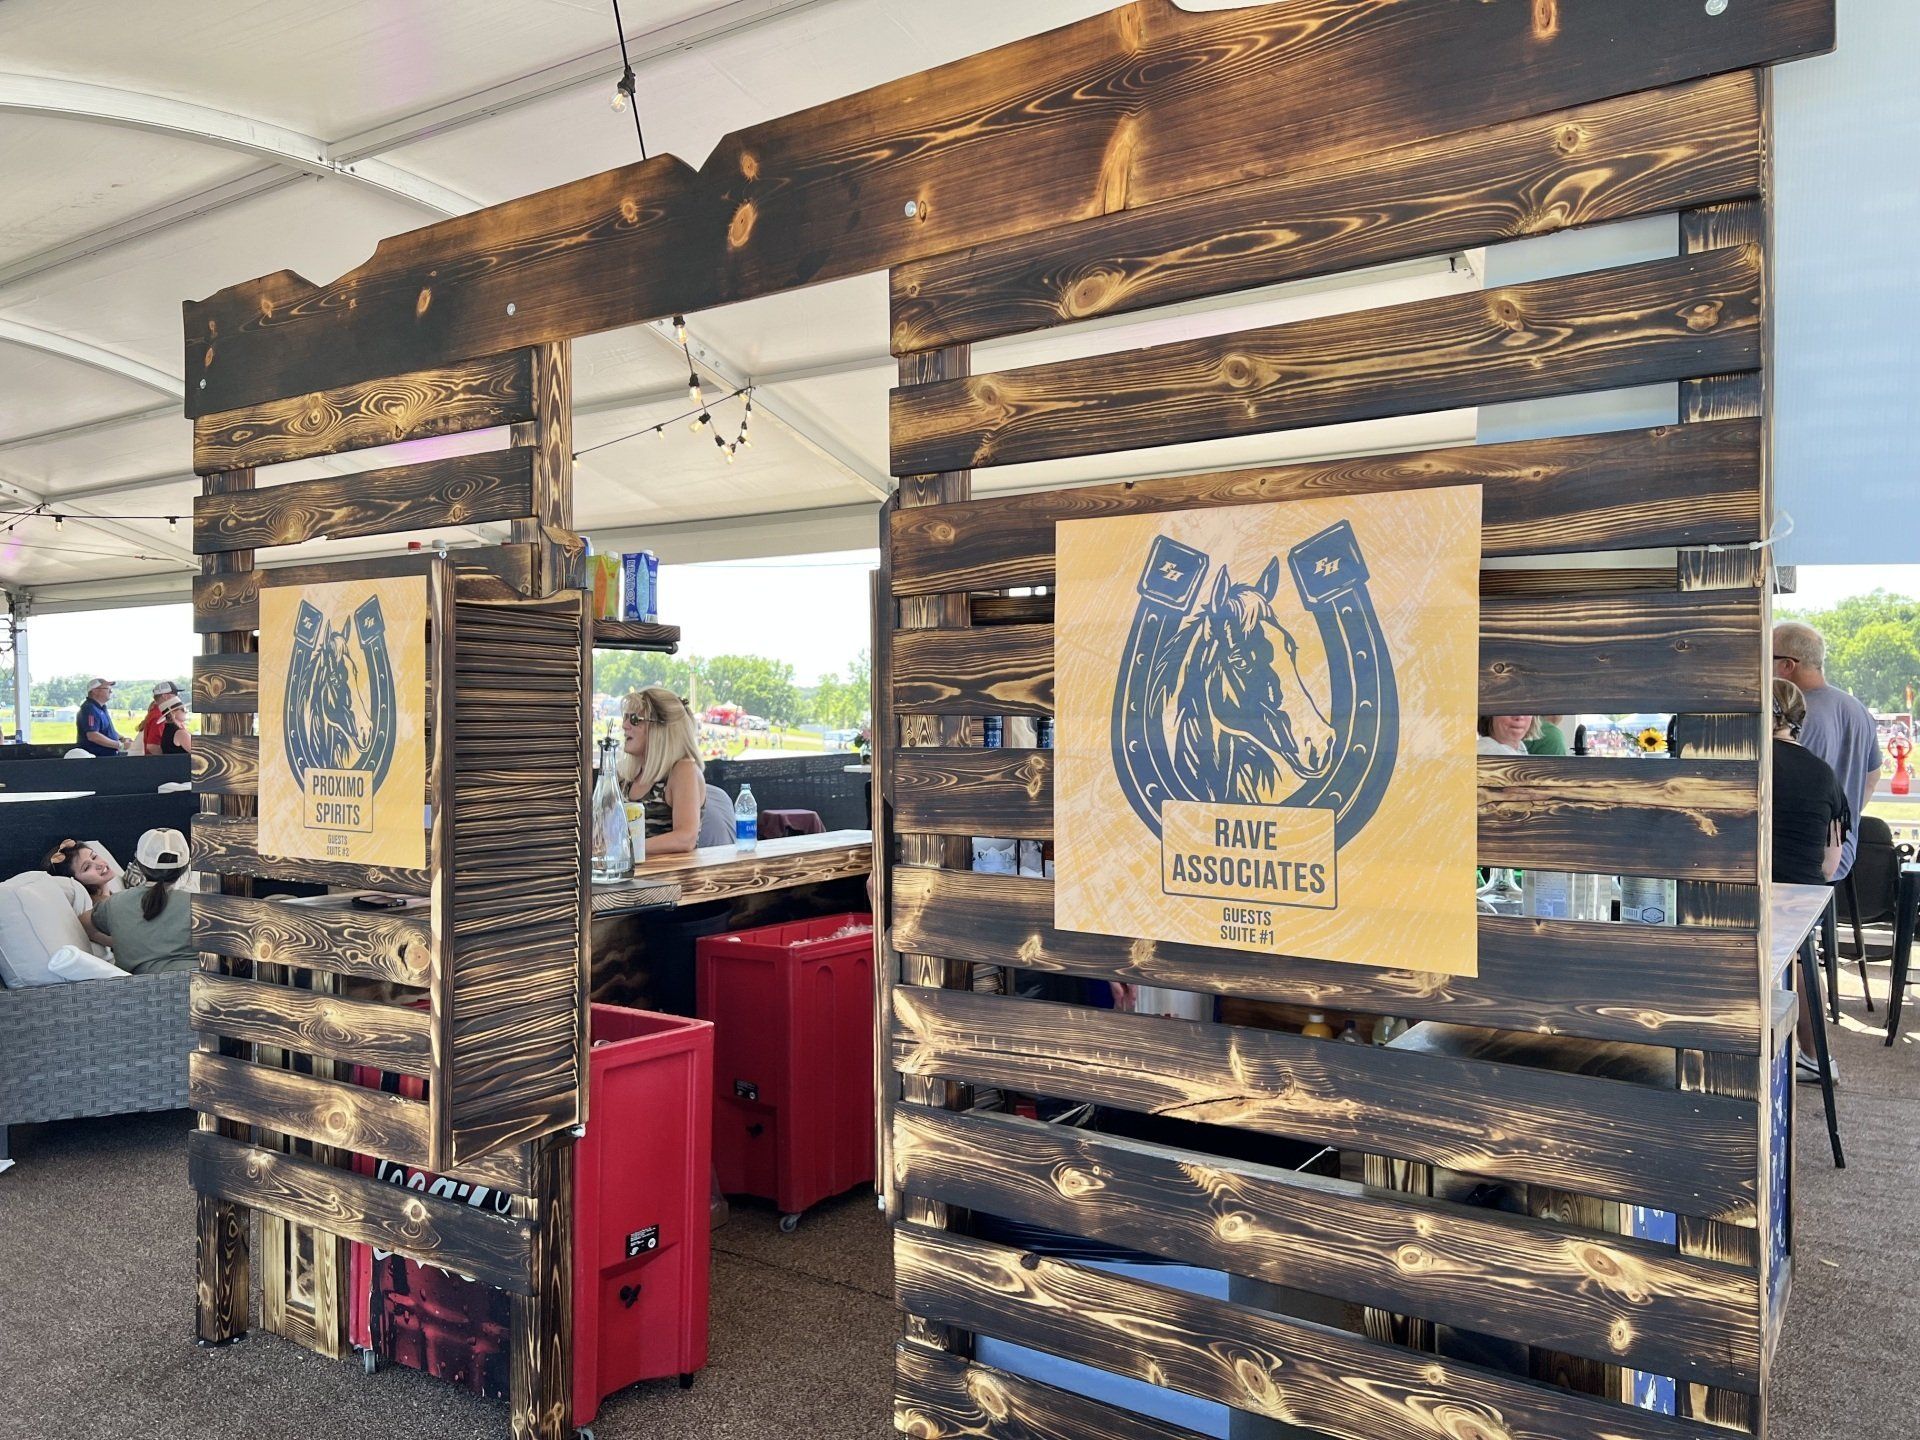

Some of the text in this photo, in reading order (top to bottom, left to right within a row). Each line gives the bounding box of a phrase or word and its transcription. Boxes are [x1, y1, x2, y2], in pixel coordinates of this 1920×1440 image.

[312, 774, 364, 798] PROXIMO
[316, 802, 360, 826] SPIRITS
[327, 834, 348, 845] GUESTS
[1215, 818, 1278, 851] RAVE
[326, 845, 350, 857] SUITE #2
[1172, 853, 1326, 894] ASSOCIATES
[1222, 907, 1272, 926] GUESTS
[1220, 925, 1275, 946] SUITE #1
